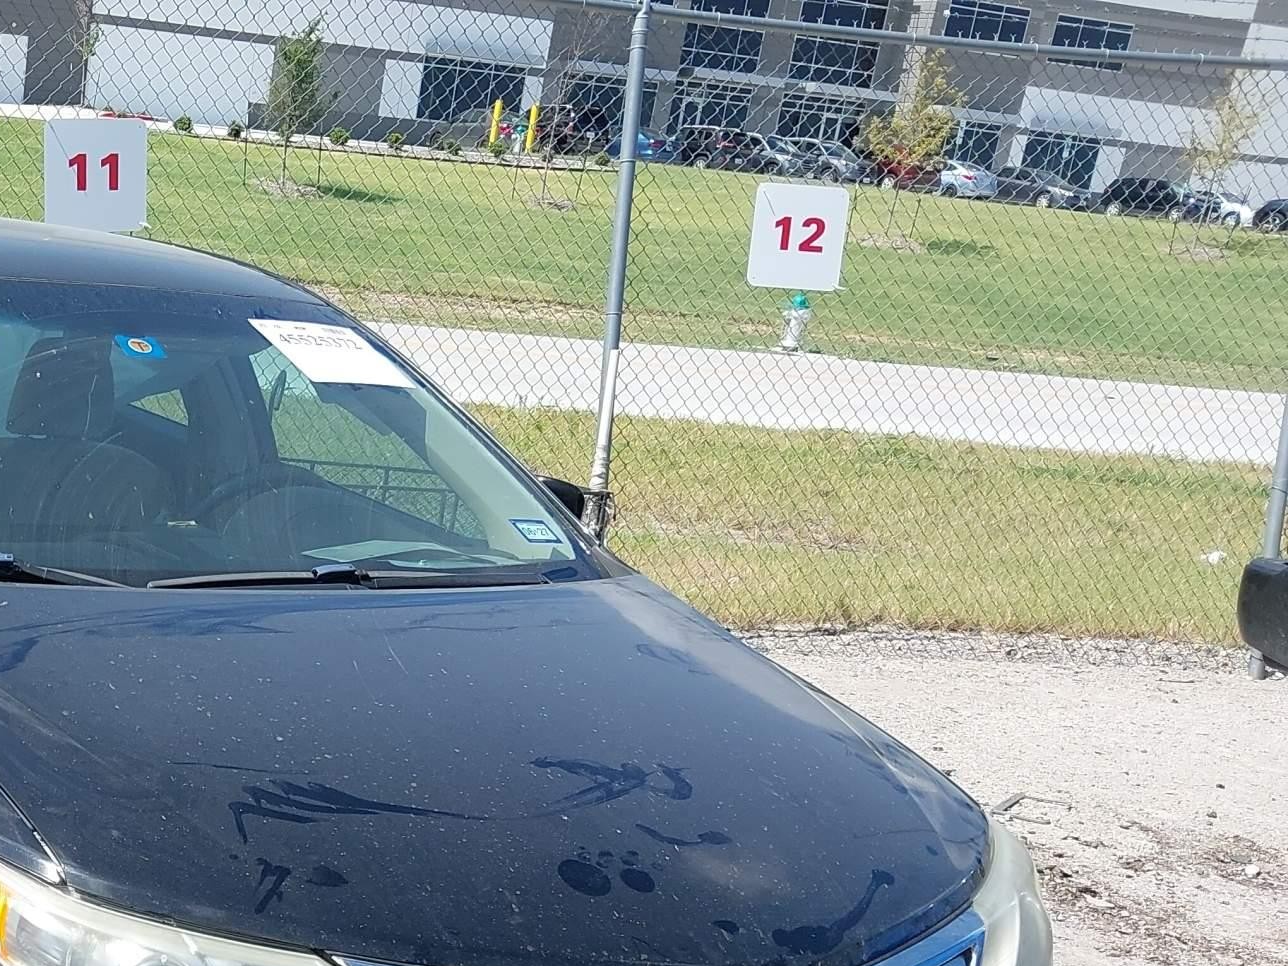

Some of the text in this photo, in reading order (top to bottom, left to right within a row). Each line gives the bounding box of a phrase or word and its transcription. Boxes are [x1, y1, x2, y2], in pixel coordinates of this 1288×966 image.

[69, 153, 119, 192] 11
[775, 216, 826, 253] 12
[279, 332, 363, 350] 45525372
